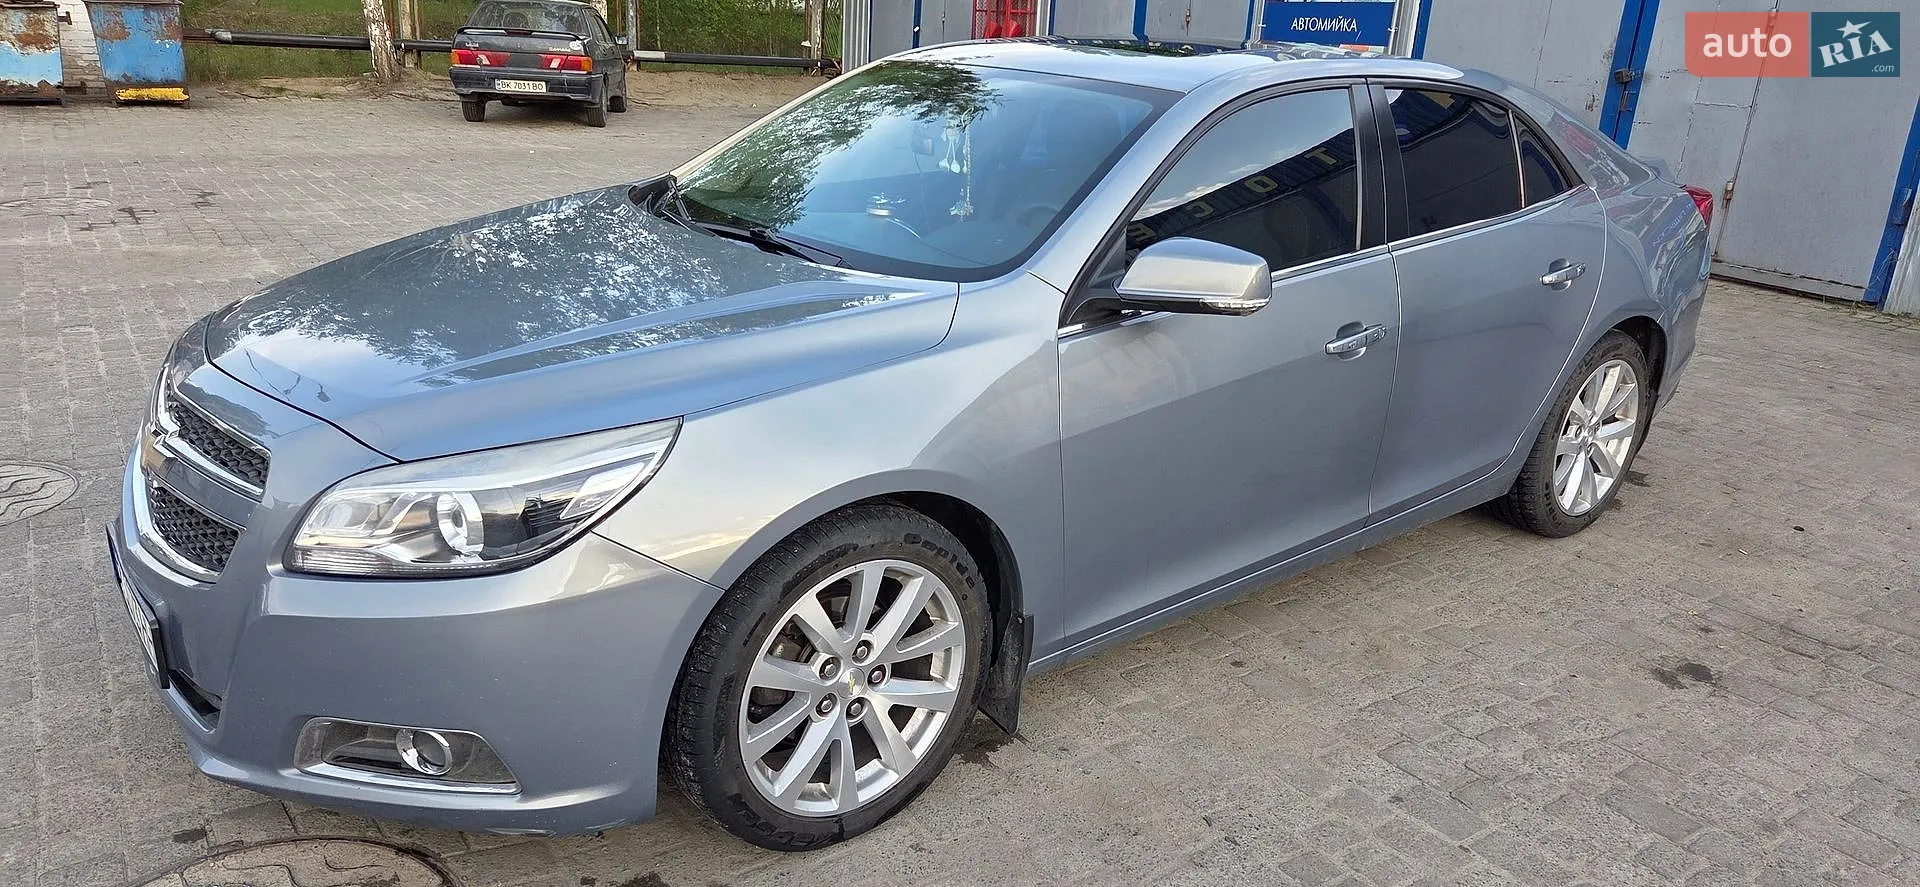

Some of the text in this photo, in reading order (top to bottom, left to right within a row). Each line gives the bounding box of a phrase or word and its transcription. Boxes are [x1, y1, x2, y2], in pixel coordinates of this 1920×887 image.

[1290, 15, 1358, 32] АВТОМИЙКА
[500, 81, 544, 91] BK 7031 BO
